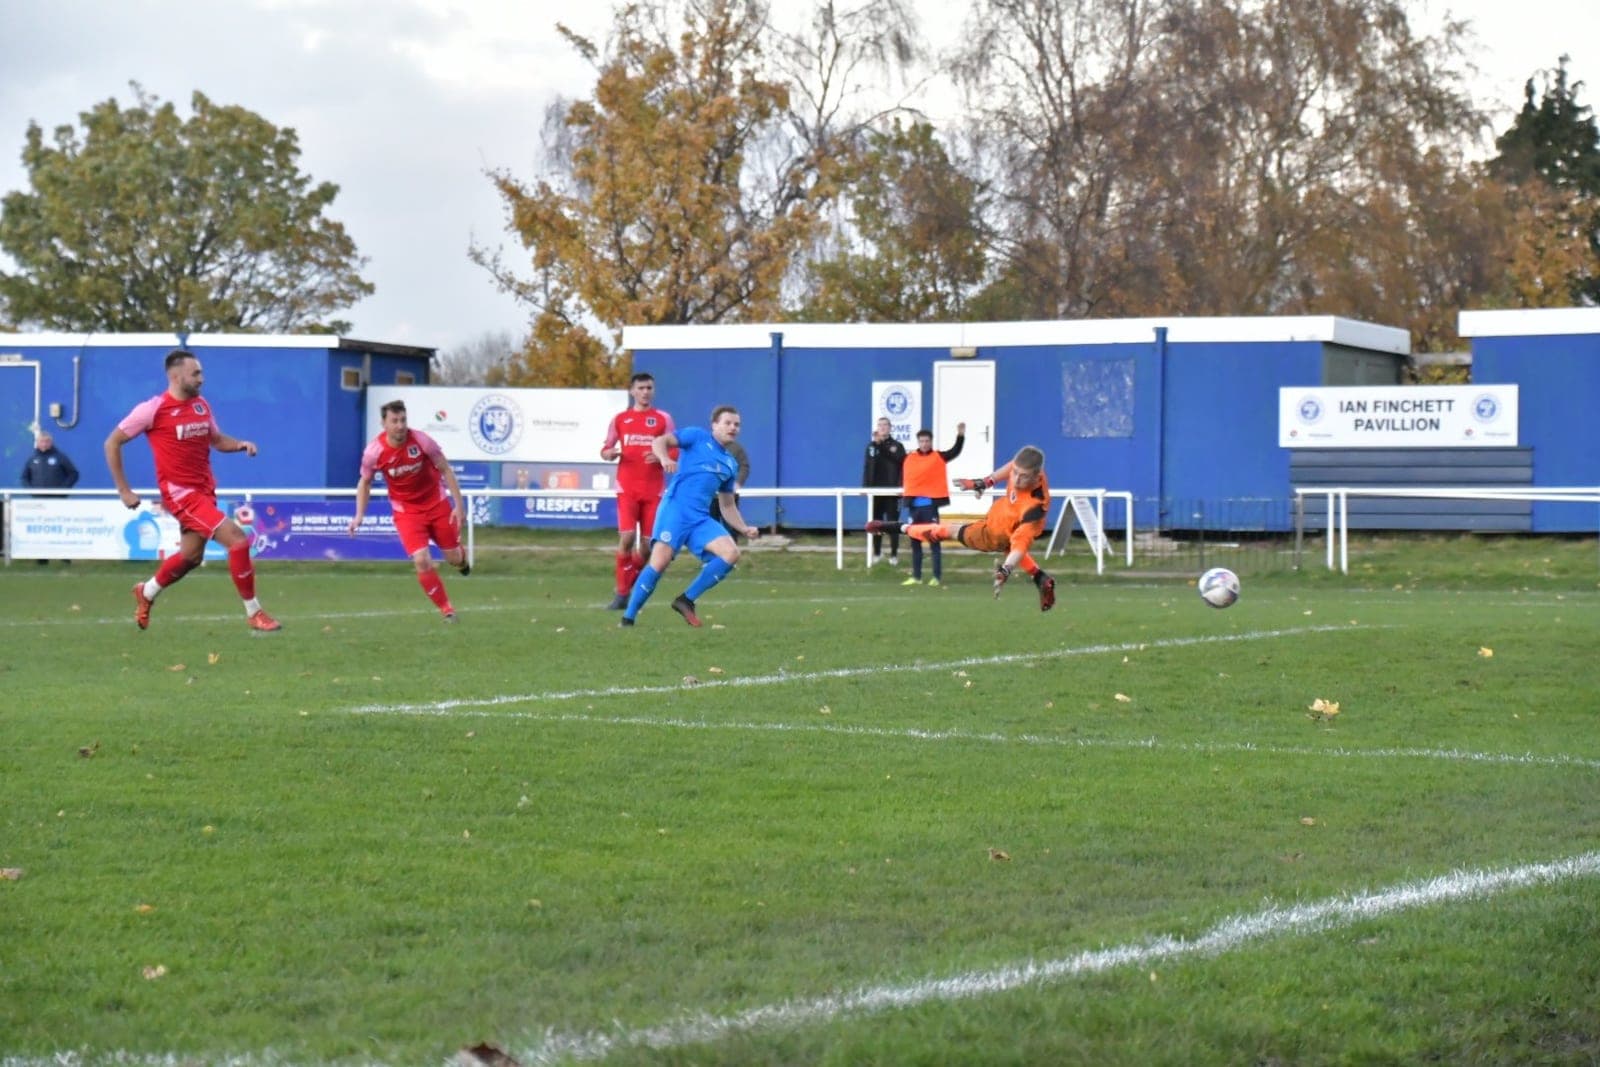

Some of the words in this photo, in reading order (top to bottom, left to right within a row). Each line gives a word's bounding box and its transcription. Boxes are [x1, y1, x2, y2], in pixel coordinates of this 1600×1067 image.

[1339, 400, 1367, 413] IAN
[1373, 399, 1455, 413] FINCHETT
[891, 424, 912, 433] OME
[1354, 418, 1440, 431] PAVILLION
[536, 498, 600, 513] RESPECT
[26, 525, 63, 534] BEFORE
